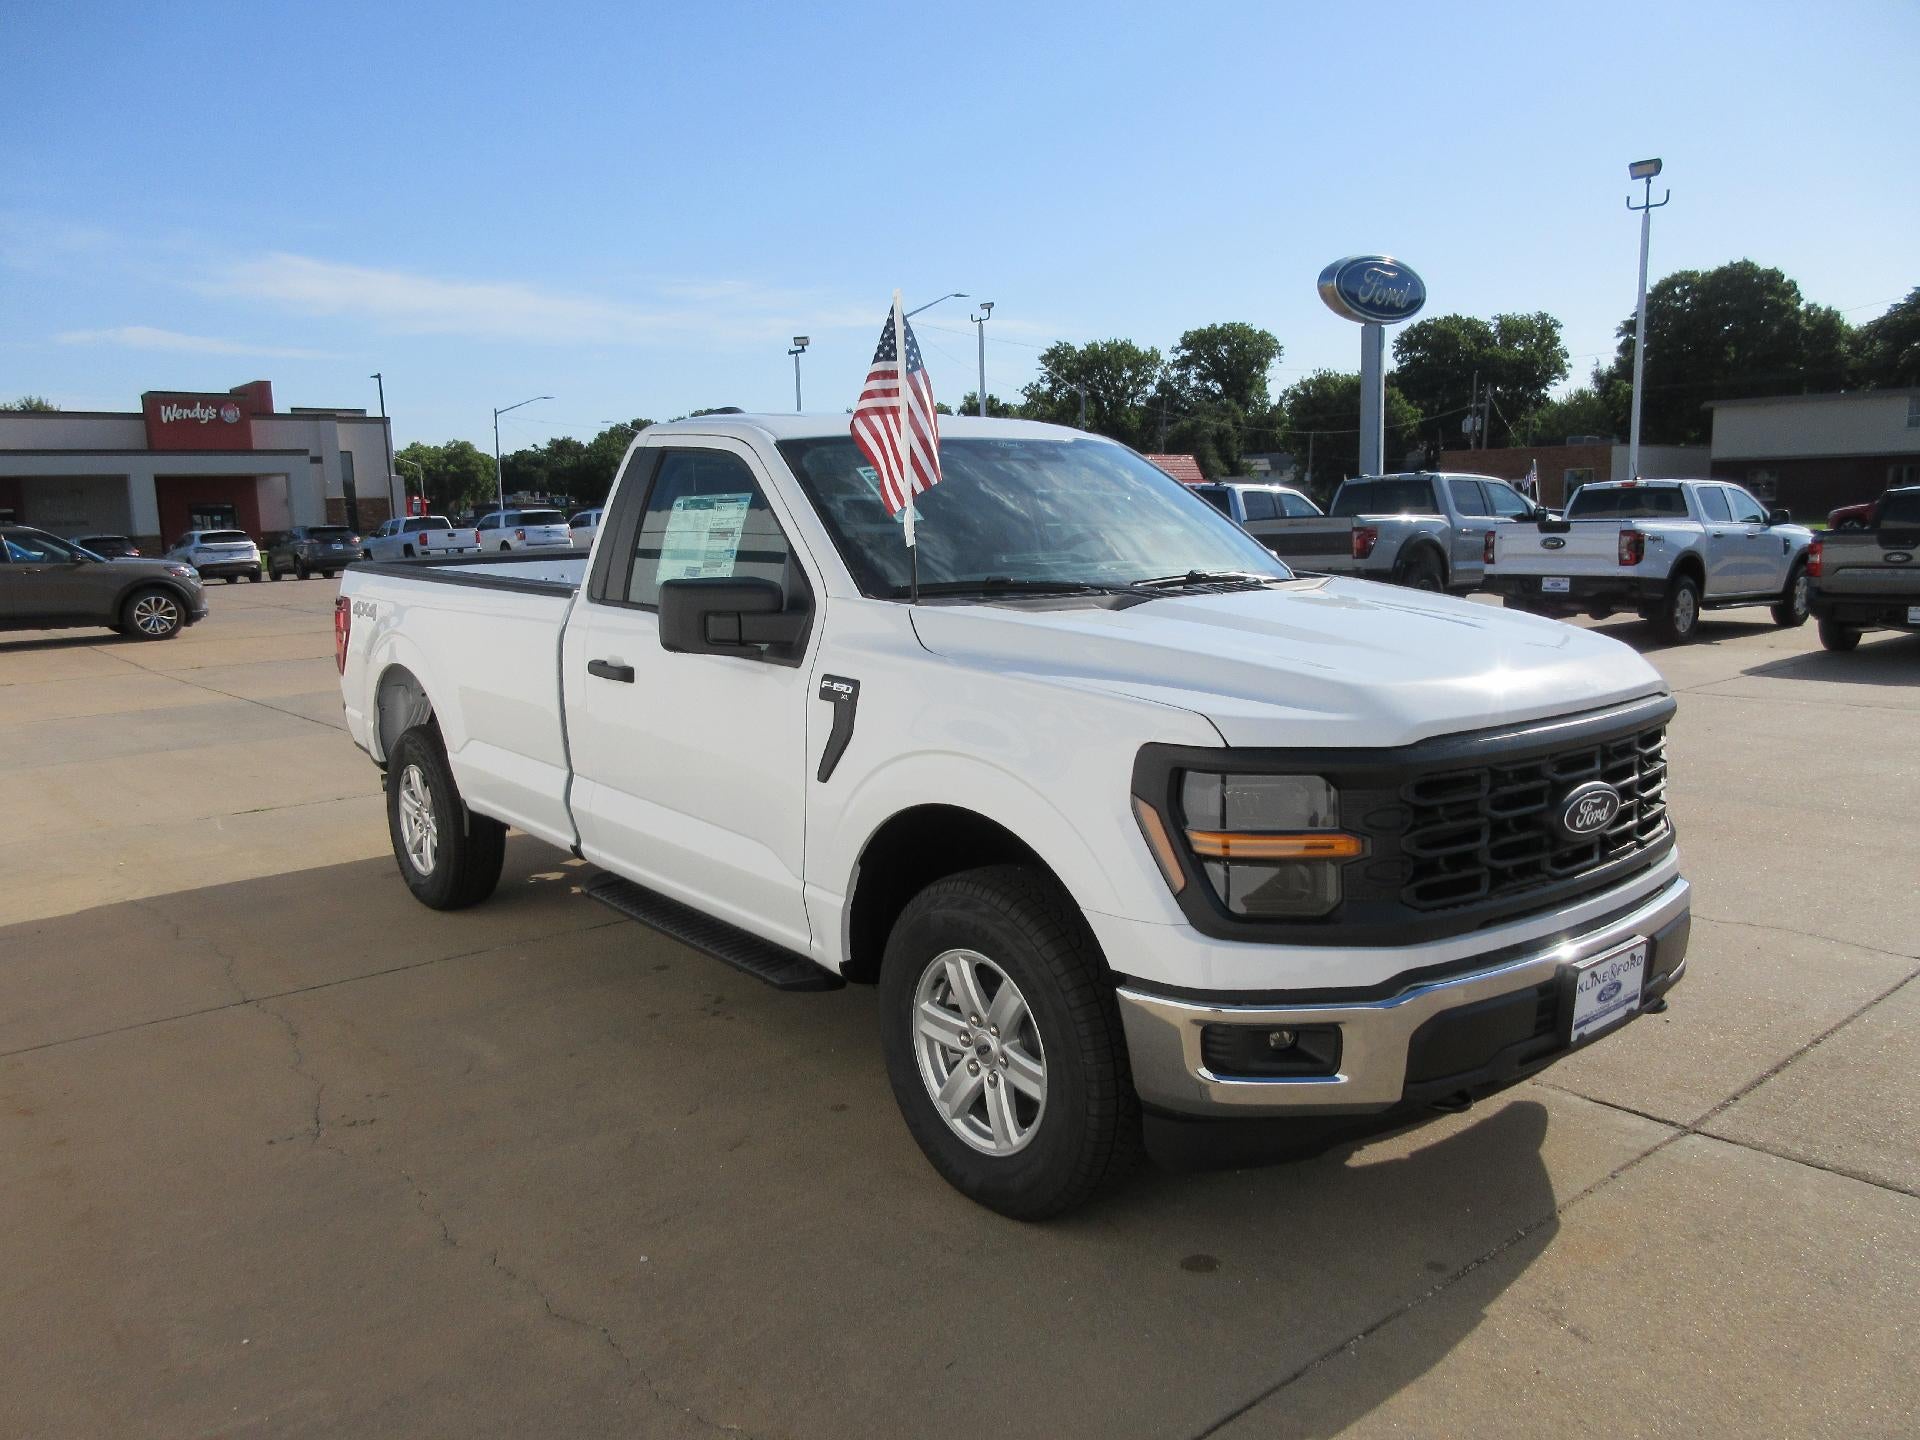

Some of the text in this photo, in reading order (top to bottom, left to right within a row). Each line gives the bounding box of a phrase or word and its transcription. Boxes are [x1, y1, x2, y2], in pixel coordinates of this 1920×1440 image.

[1358, 267, 1411, 309] Ford
[161, 402, 217, 424] Wendy's
[1575, 797, 1609, 828] Ford
[1617, 955, 1643, 976] FORD
